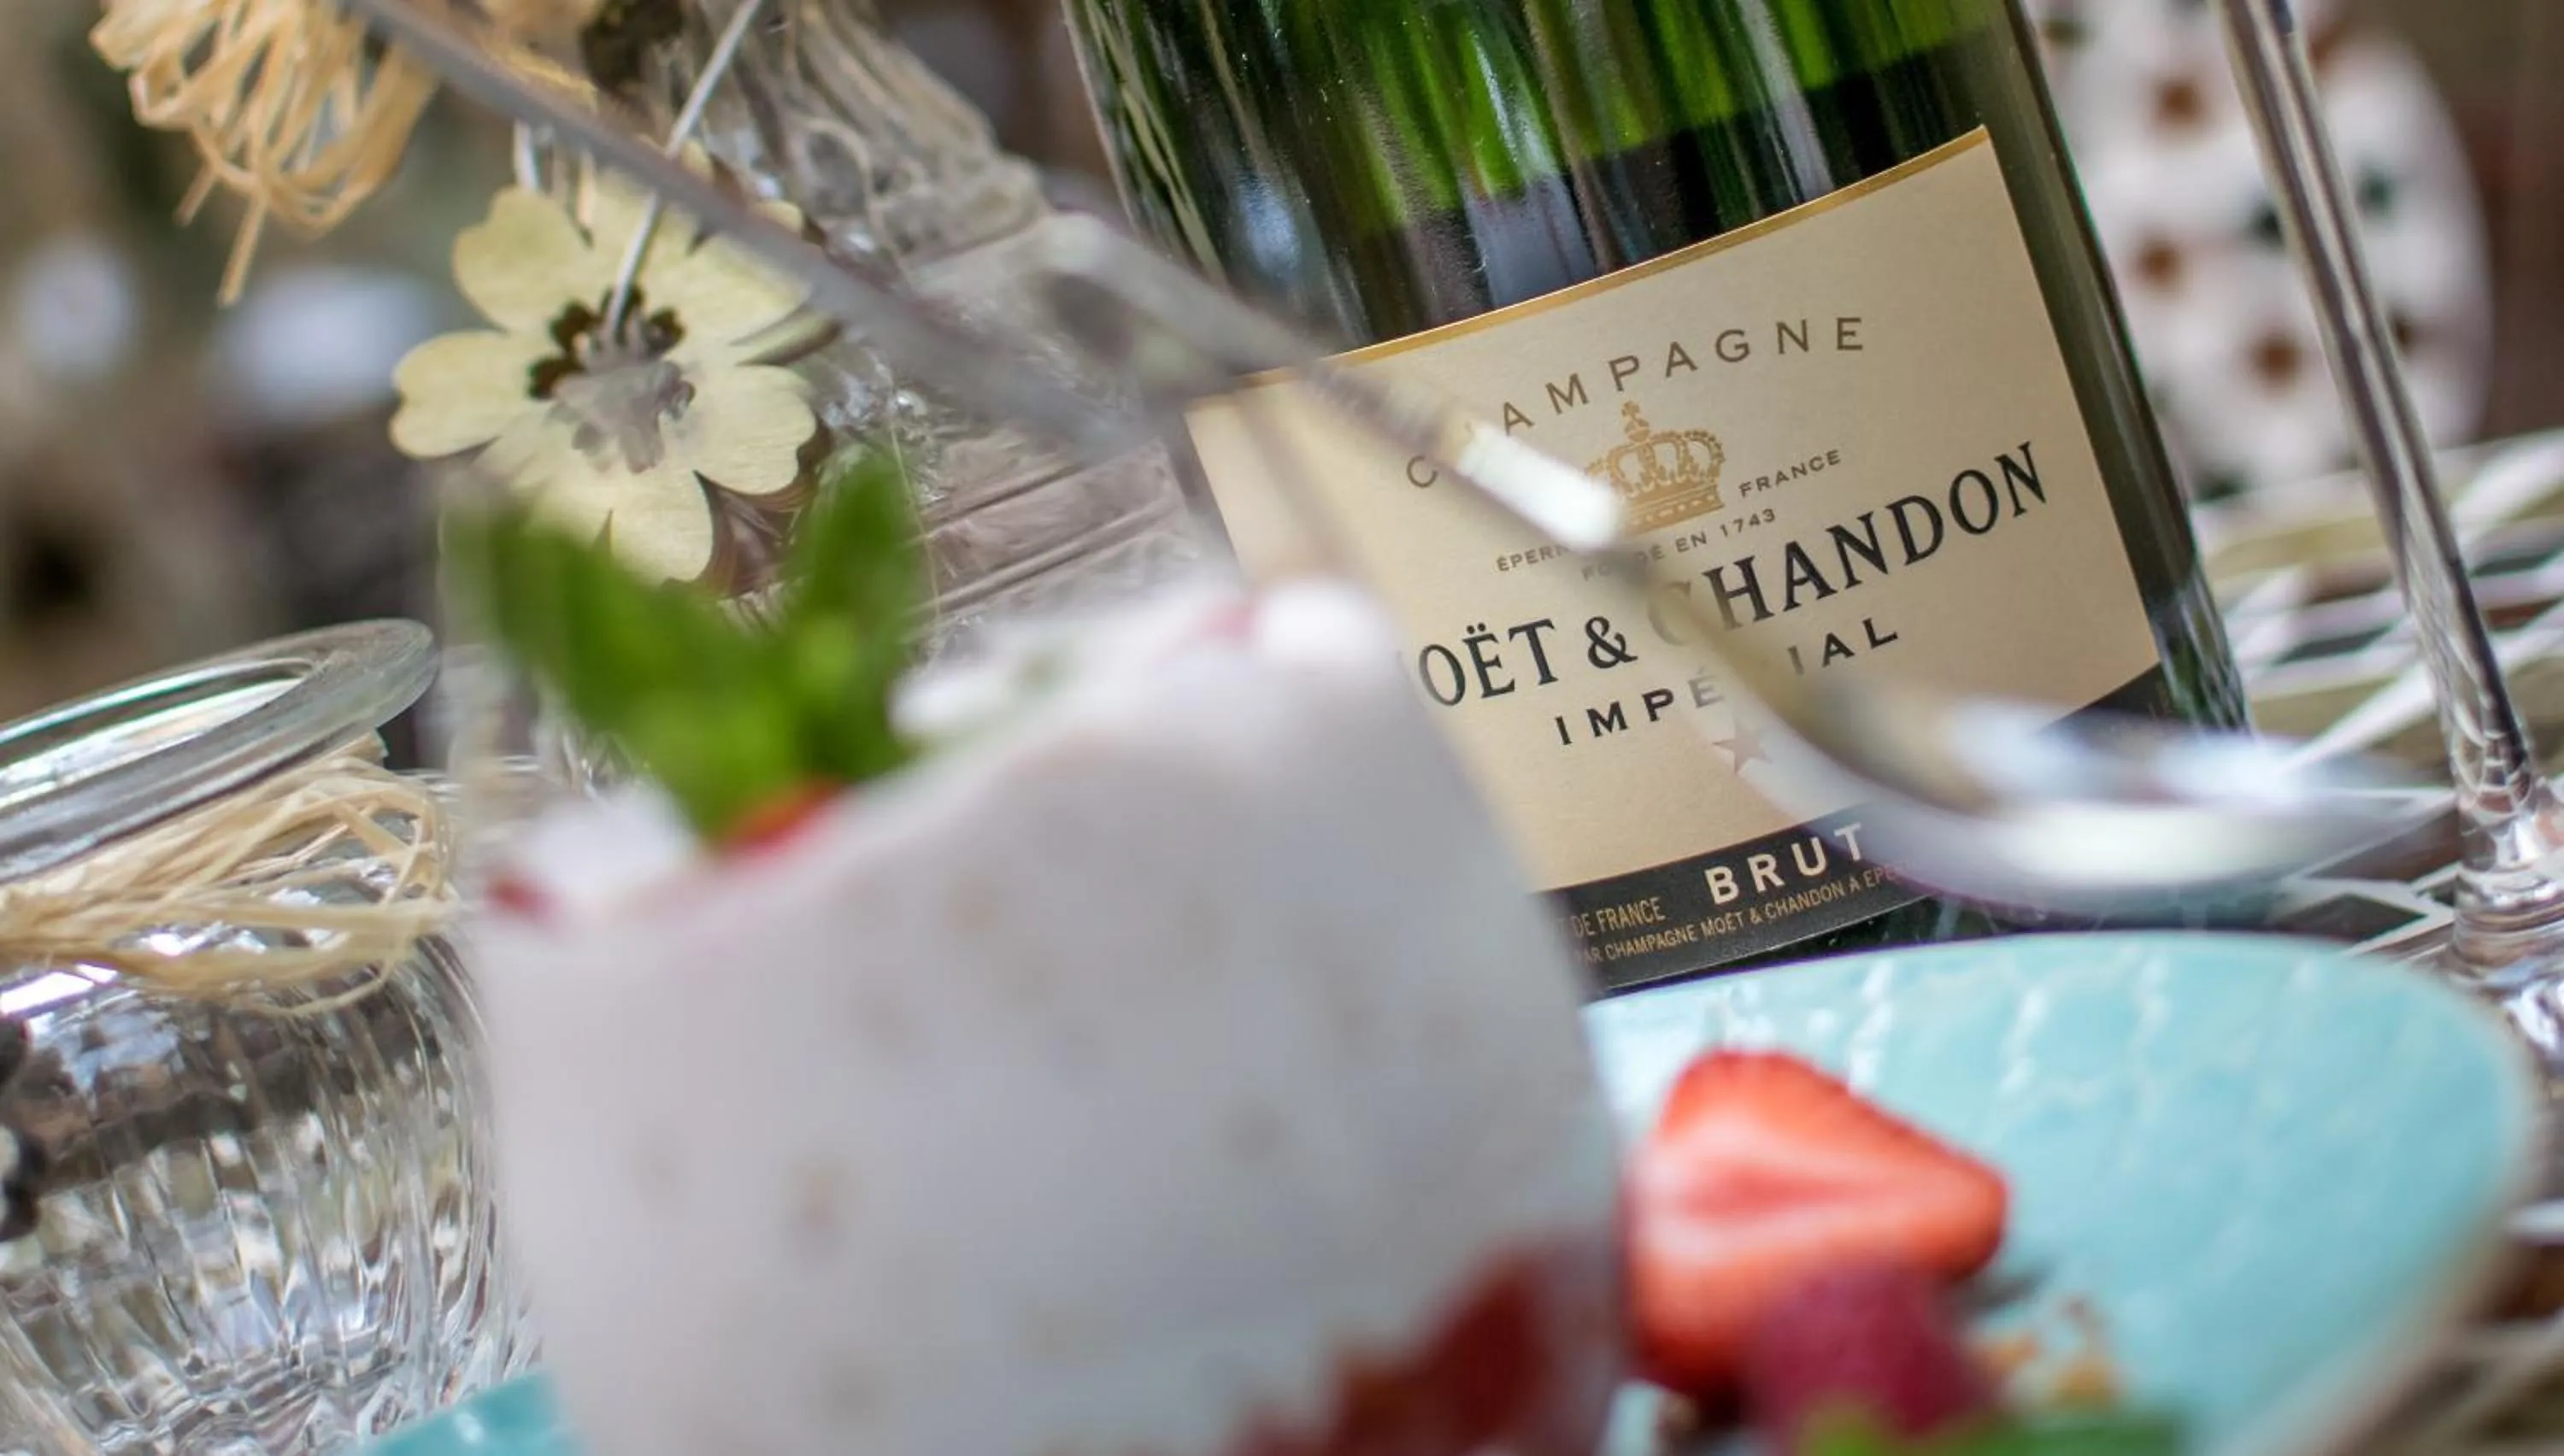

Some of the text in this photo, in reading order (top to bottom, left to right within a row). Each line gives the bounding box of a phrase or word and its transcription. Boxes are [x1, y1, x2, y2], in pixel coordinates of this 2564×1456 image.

[1406, 317, 1864, 490] CAMPAGNE
[1497, 449, 1842, 572] ÉPERN FRANCE
[1581, 508, 1777, 581] FODÉ EN 1743
[1410, 440, 2048, 708] OËT & CHANDON
[1555, 617, 1899, 746] IMPÉIAL
[1703, 821, 1862, 906] BRUT
[1569, 912, 1597, 938] DE
[1596, 895, 1667, 934] FRANCE
[1604, 924, 1698, 960] CHAMPAGNE
[1750, 907, 1763, 925] &
[1764, 882, 1846, 920] CHANDON
